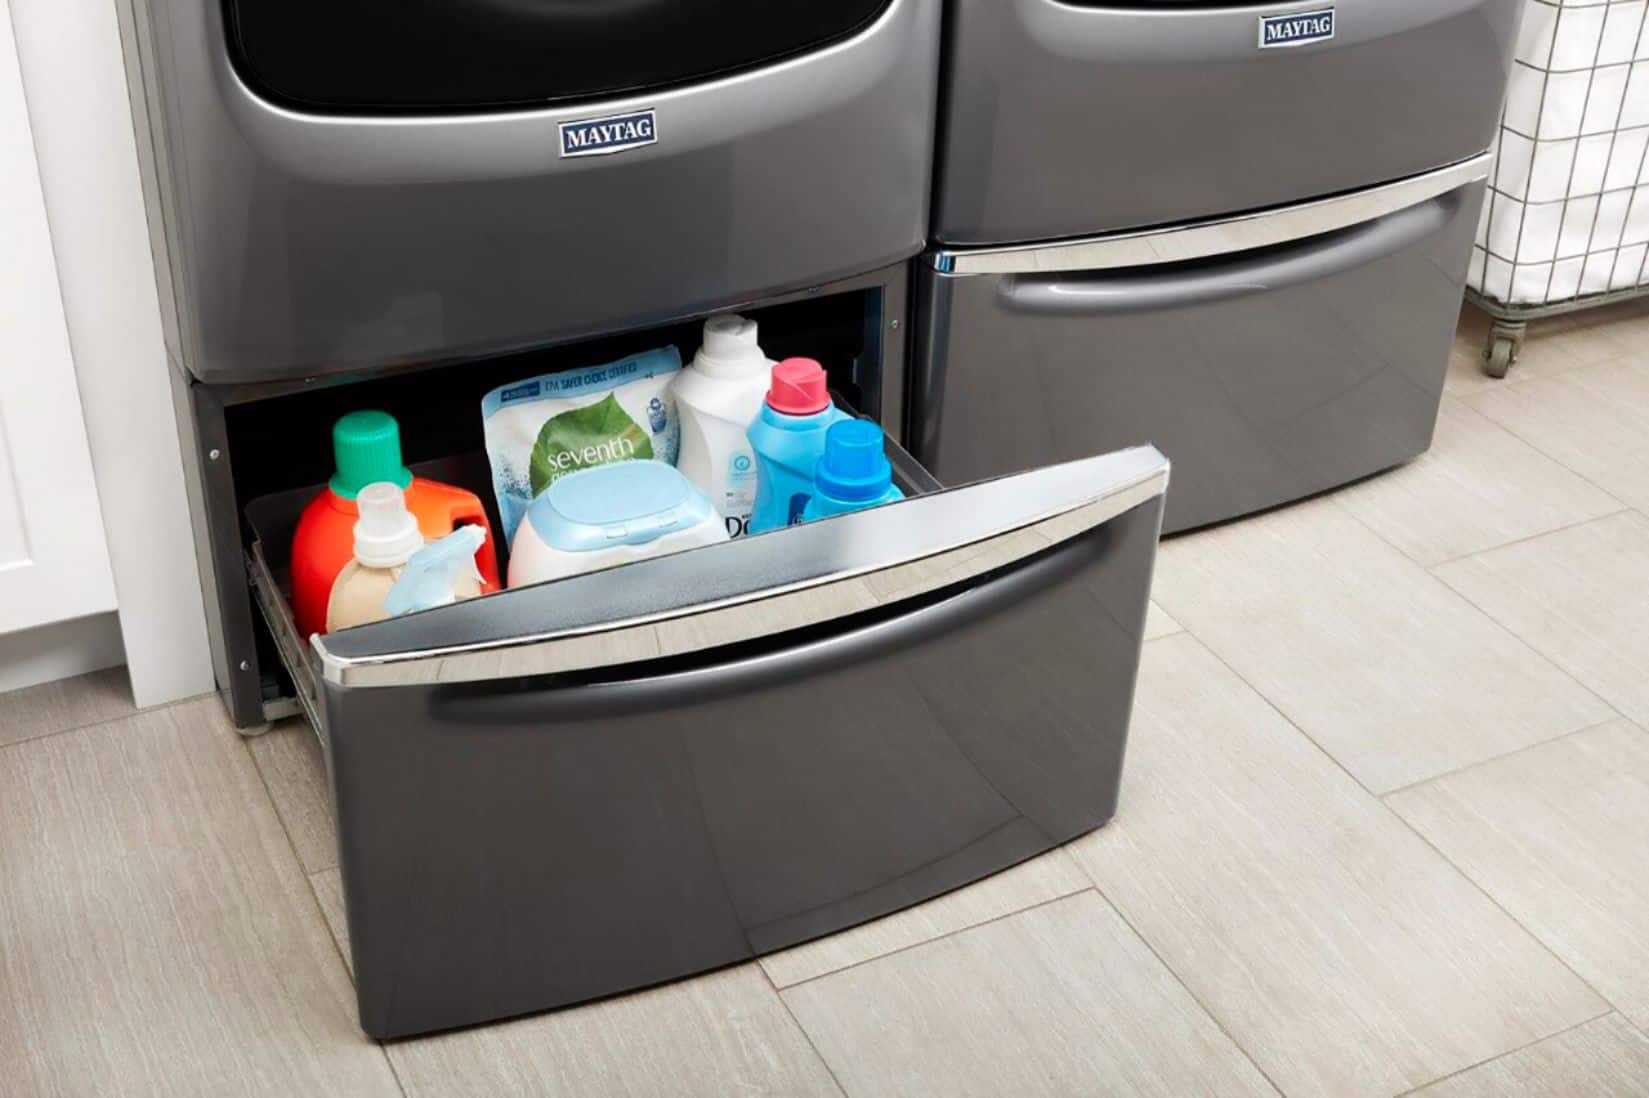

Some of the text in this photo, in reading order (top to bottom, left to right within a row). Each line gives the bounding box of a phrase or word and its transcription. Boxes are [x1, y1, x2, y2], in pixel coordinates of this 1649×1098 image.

[1266, 16, 1331, 41] MAYTAG
[565, 118, 652, 149] MAYTAG
[561, 375, 583, 390] SAFER
[583, 370, 608, 385] CHOICE
[547, 436, 635, 472] seventh
